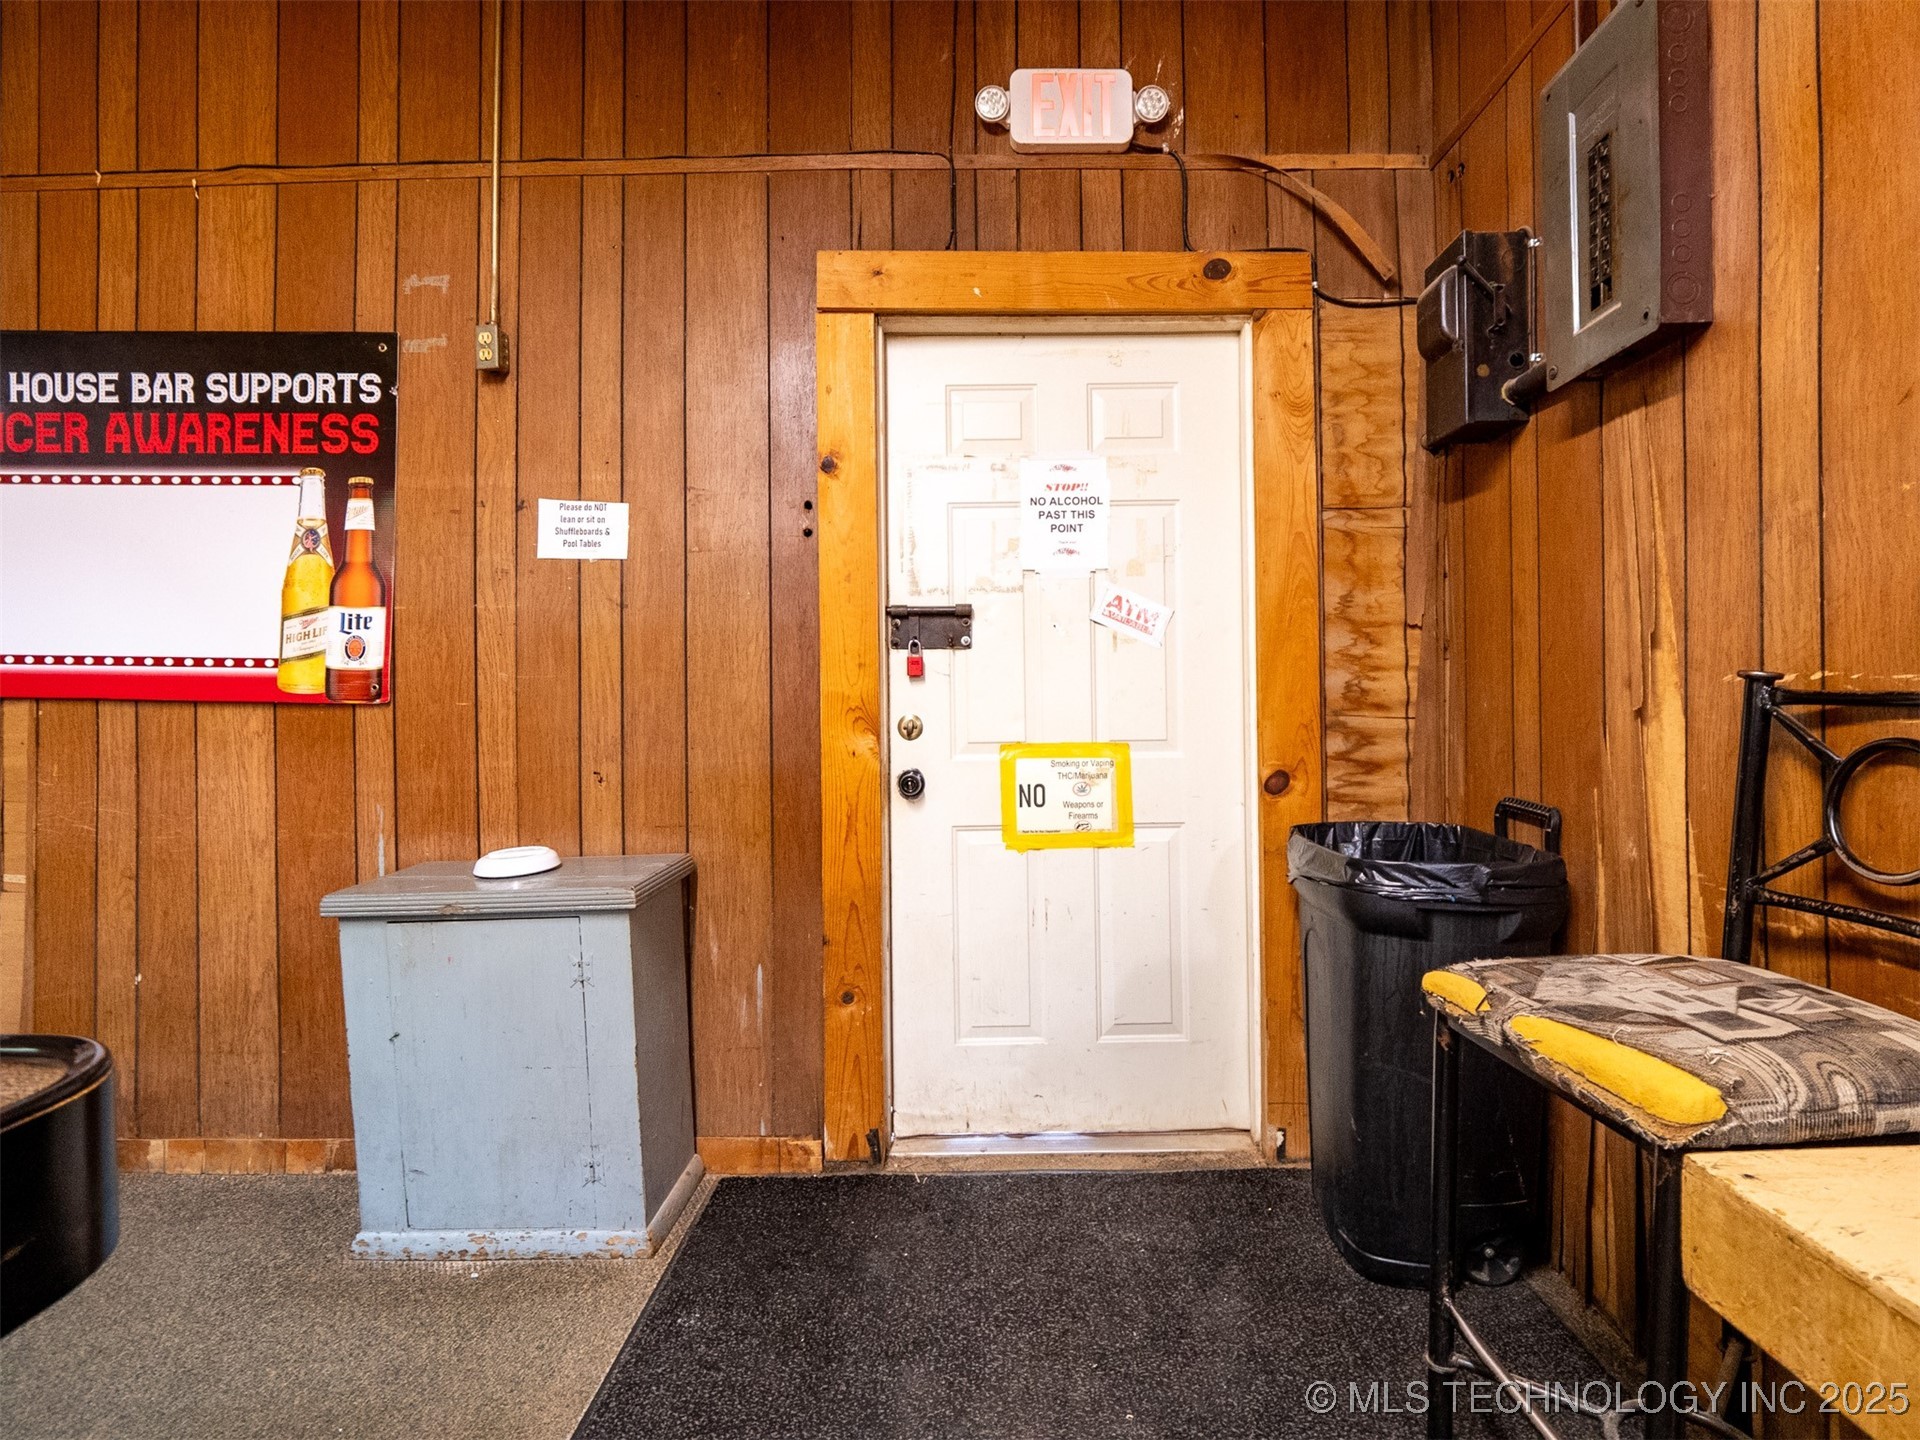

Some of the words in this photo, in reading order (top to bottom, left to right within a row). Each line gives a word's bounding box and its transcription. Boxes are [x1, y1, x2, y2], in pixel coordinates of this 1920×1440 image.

[1032, 73, 1116, 137] EXIT
[8, 372, 120, 403] HOUSE
[131, 372, 195, 403] BAR
[206, 372, 382, 403] SUPPORTS
[0, 412, 90, 454] CER
[105, 412, 379, 454] AWARENESS
[1045, 483, 1089, 491] STOP!!
[1030, 497, 1046, 506] NO
[1049, 496, 1103, 506] ALCOHOL
[559, 503, 582, 511] Please
[584, 503, 592, 511] do
[594, 503, 607, 511] NOT
[560, 515, 575, 523] lean
[1038, 510, 1067, 519] PAST
[1071, 510, 1095, 519] THIS
[555, 527, 603, 535] Shuffleboards
[1050, 523, 1083, 532] POINT
[339, 612, 373, 635] Lite
[312, 626, 328, 638] LIF
[1050, 760, 1080, 769] Smoking
[1090, 760, 1114, 768] Vaping
[1057, 772, 1108, 780] THC/Marijuana
[1019, 783, 1046, 808] NO
[1063, 801, 1094, 809] Weapons
